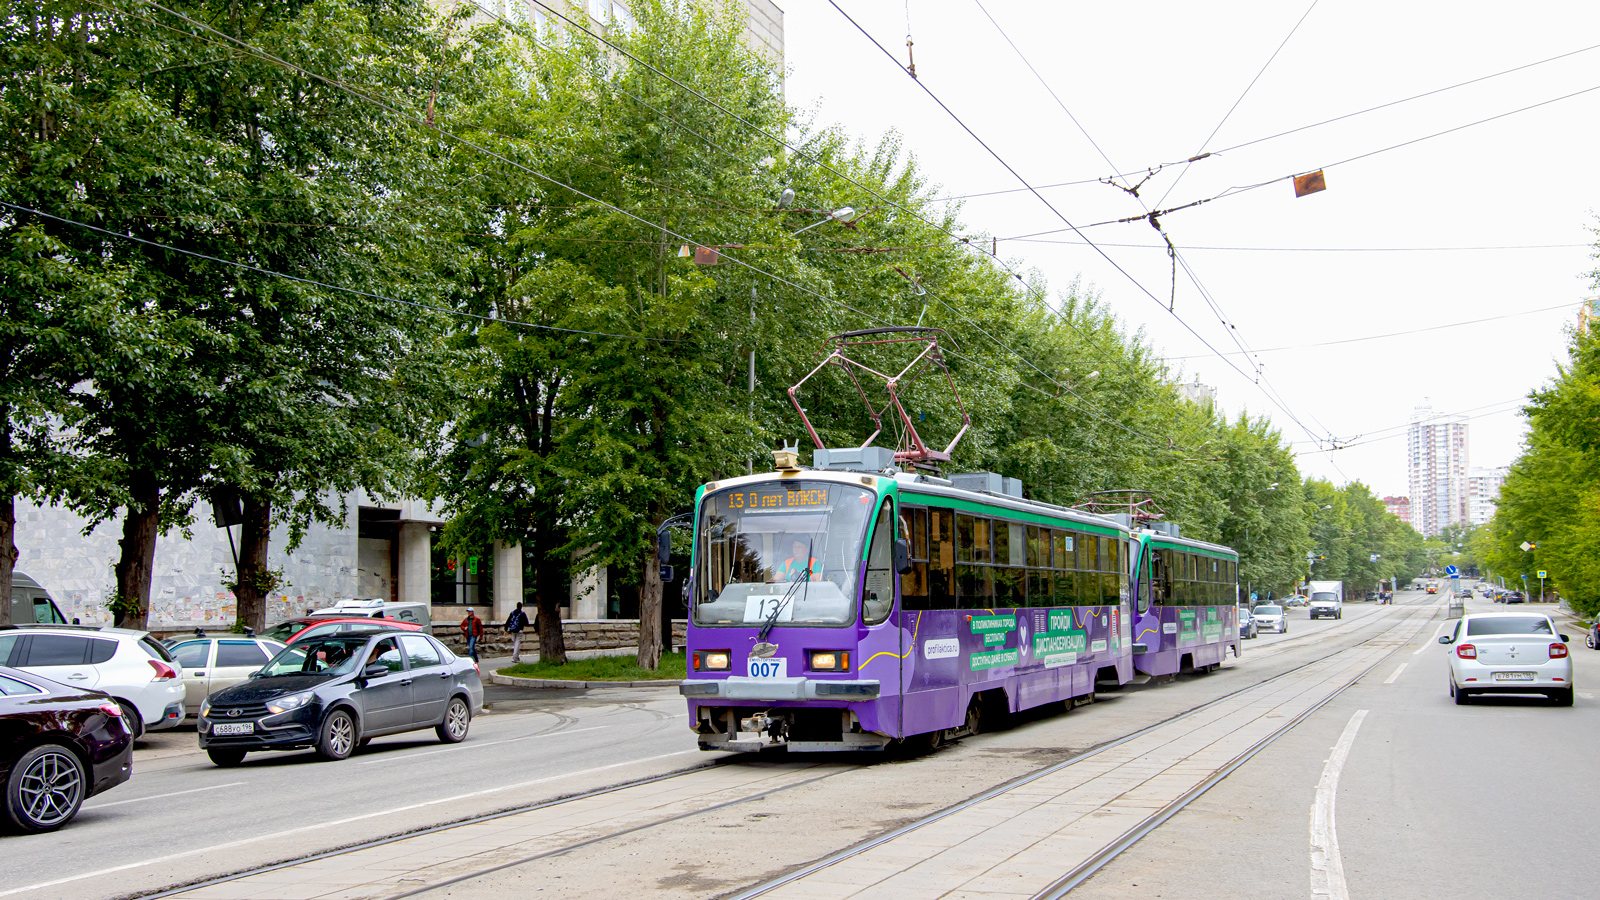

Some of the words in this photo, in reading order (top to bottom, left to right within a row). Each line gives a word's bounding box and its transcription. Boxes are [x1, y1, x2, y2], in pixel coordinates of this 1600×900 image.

[729, 493, 744, 508] 13
[762, 494, 784, 507] лет
[759, 599, 780, 620] 13
[1051, 612, 1071, 632] ПРОЙДИ
[927, 643, 958, 655] profilaktica.ru
[1036, 635, 1084, 656] ДИСПАНСЕРИЗАЦИЮ
[751, 663, 780, 677] 007
